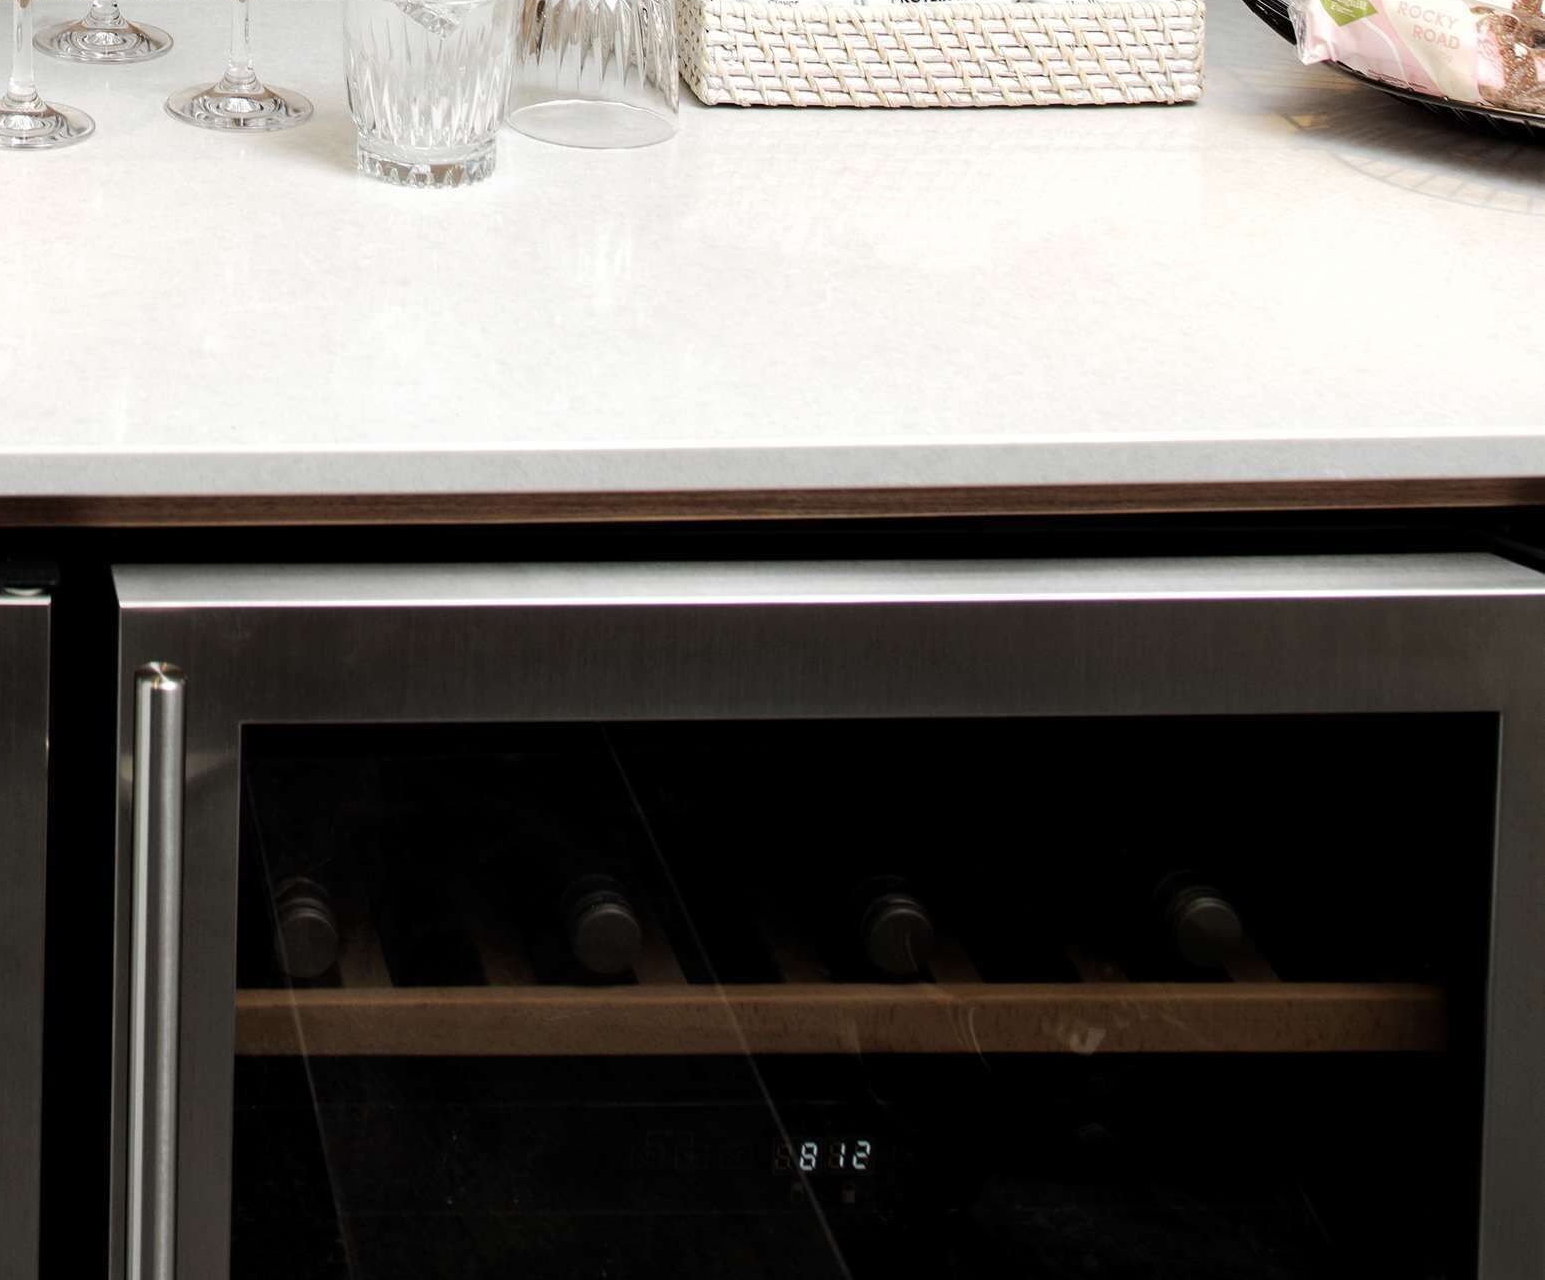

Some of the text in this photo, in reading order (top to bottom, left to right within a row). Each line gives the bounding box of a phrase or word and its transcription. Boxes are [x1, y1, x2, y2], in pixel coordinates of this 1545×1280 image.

[1397, 1, 1457, 27] ROCKY
[1412, 26, 1461, 50] ROAD
[839, 1141, 871, 1169] 12
